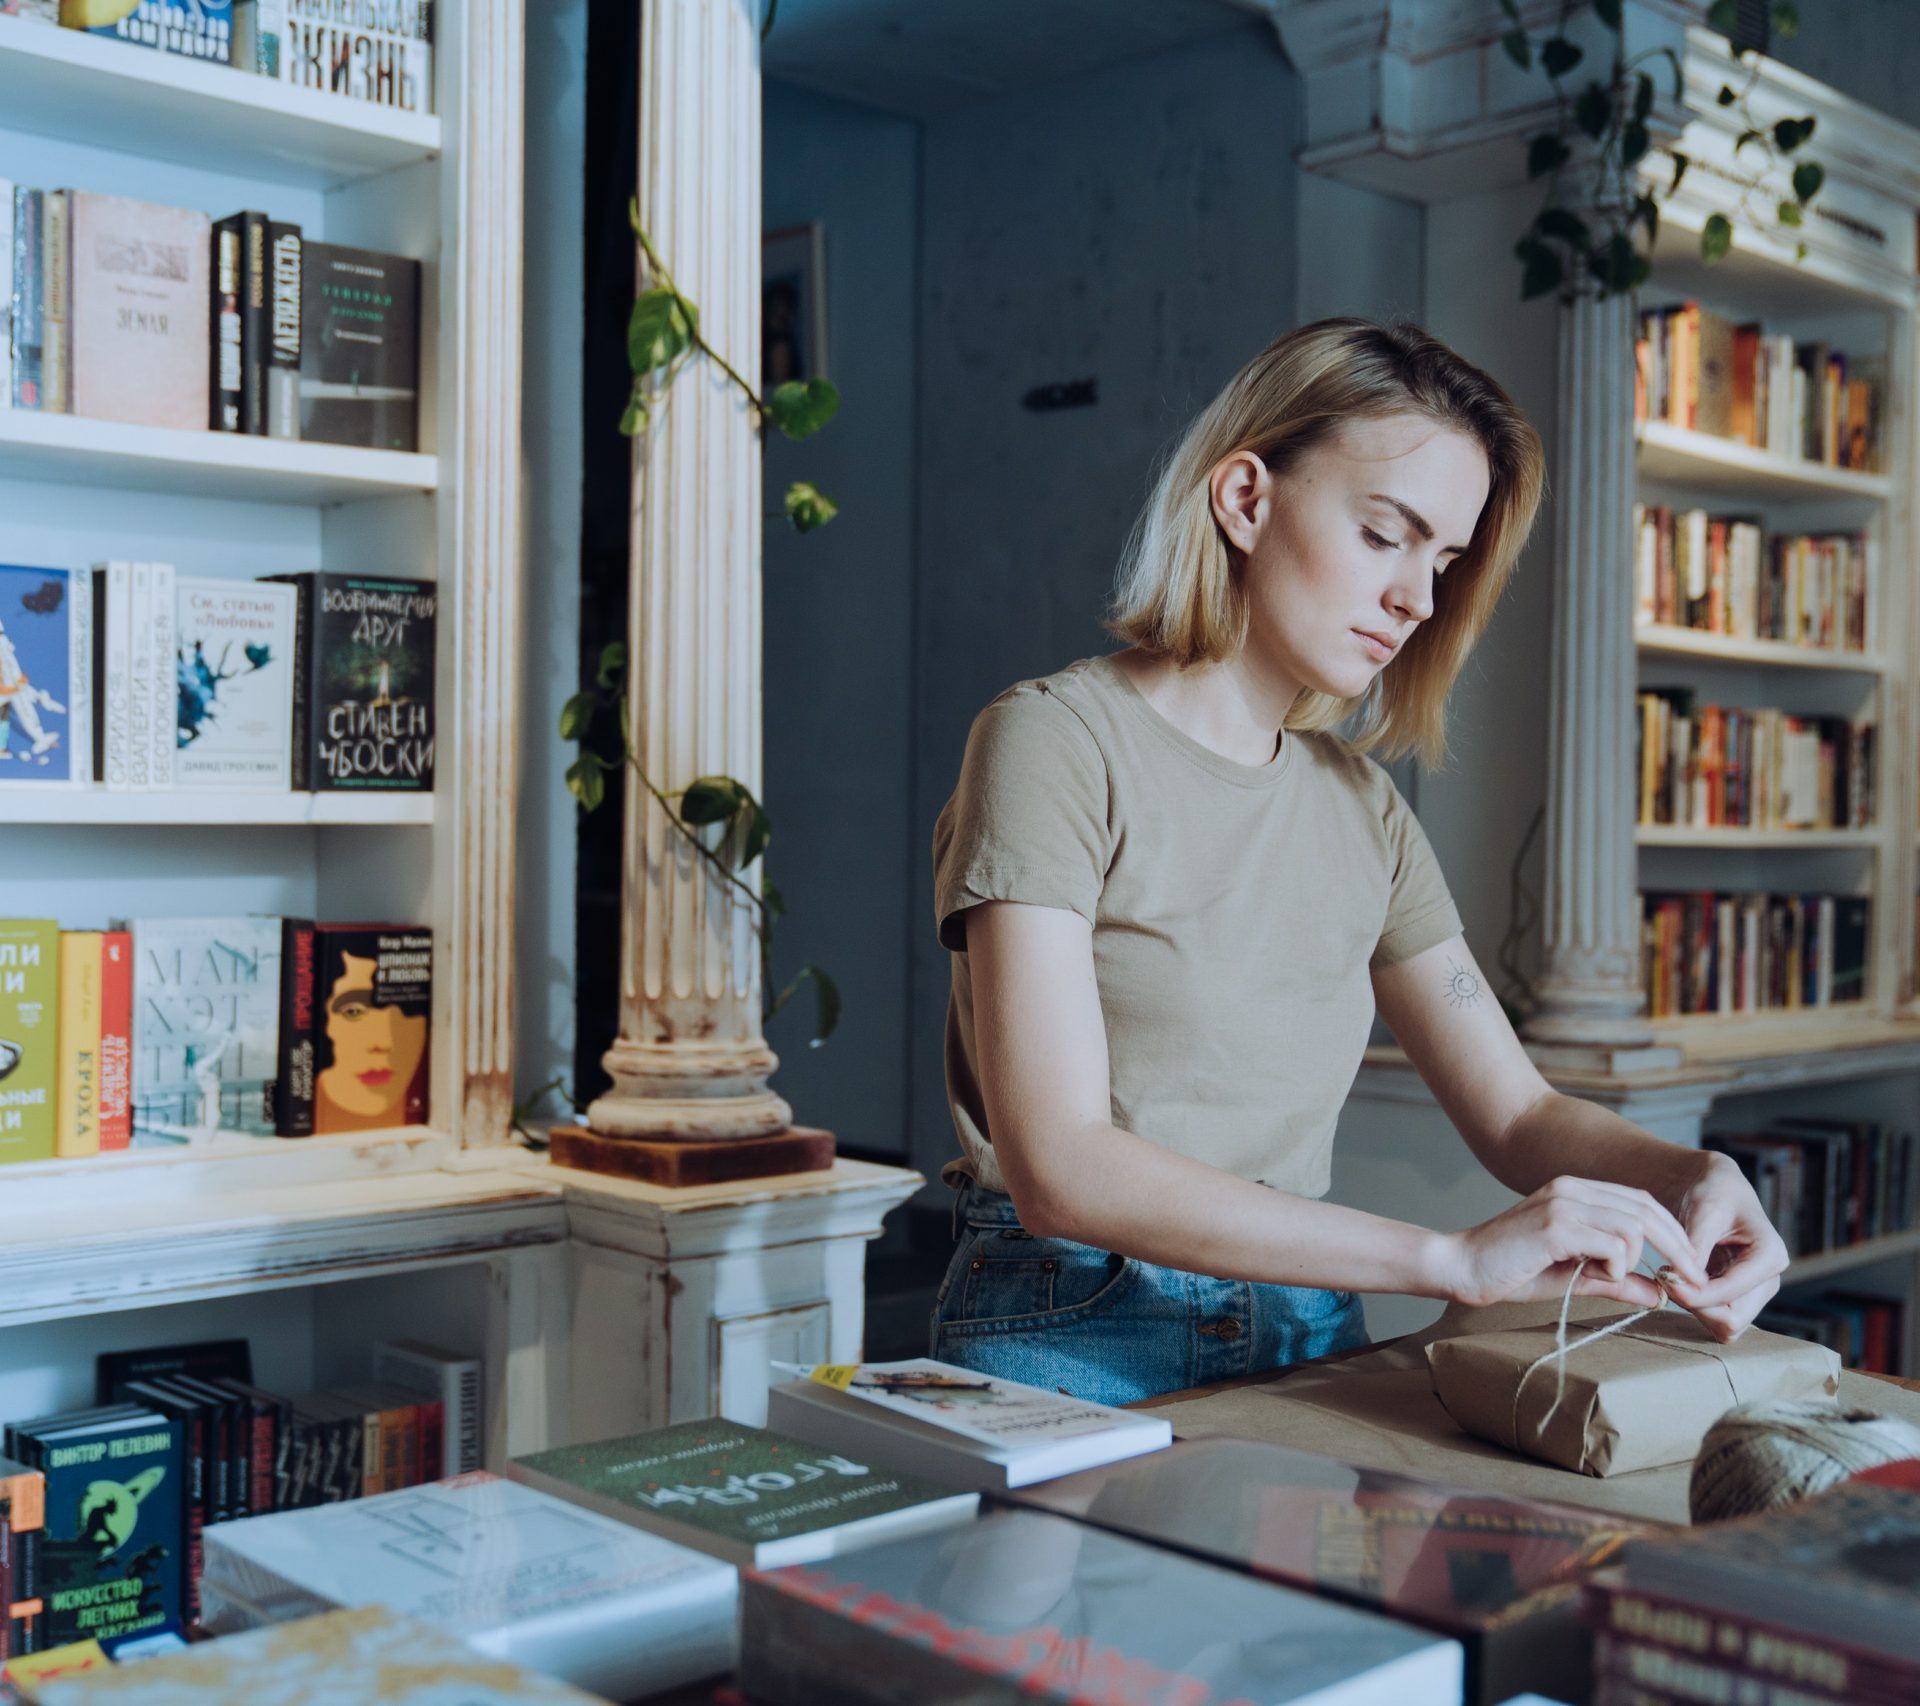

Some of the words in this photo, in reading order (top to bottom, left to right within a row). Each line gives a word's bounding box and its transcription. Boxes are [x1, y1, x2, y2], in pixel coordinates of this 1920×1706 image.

[288, 20, 416, 112] ЖИЗНЬ
[352, 615, 411, 648] ДРУГ
[328, 700, 427, 740] СТИВЕН
[110, 698, 127, 784] СИРИУС
[319, 738, 434, 777] ЧБОСКИ
[77, 1050, 94, 1137] КРОХА
[51, 1442, 107, 1468] ВИКТОР
[108, 1432, 171, 1459] ПЕЛЕВИН
[51, 1577, 143, 1611] ИСКУССТВО
[77, 1600, 139, 1629] ЛЕГКИХ
